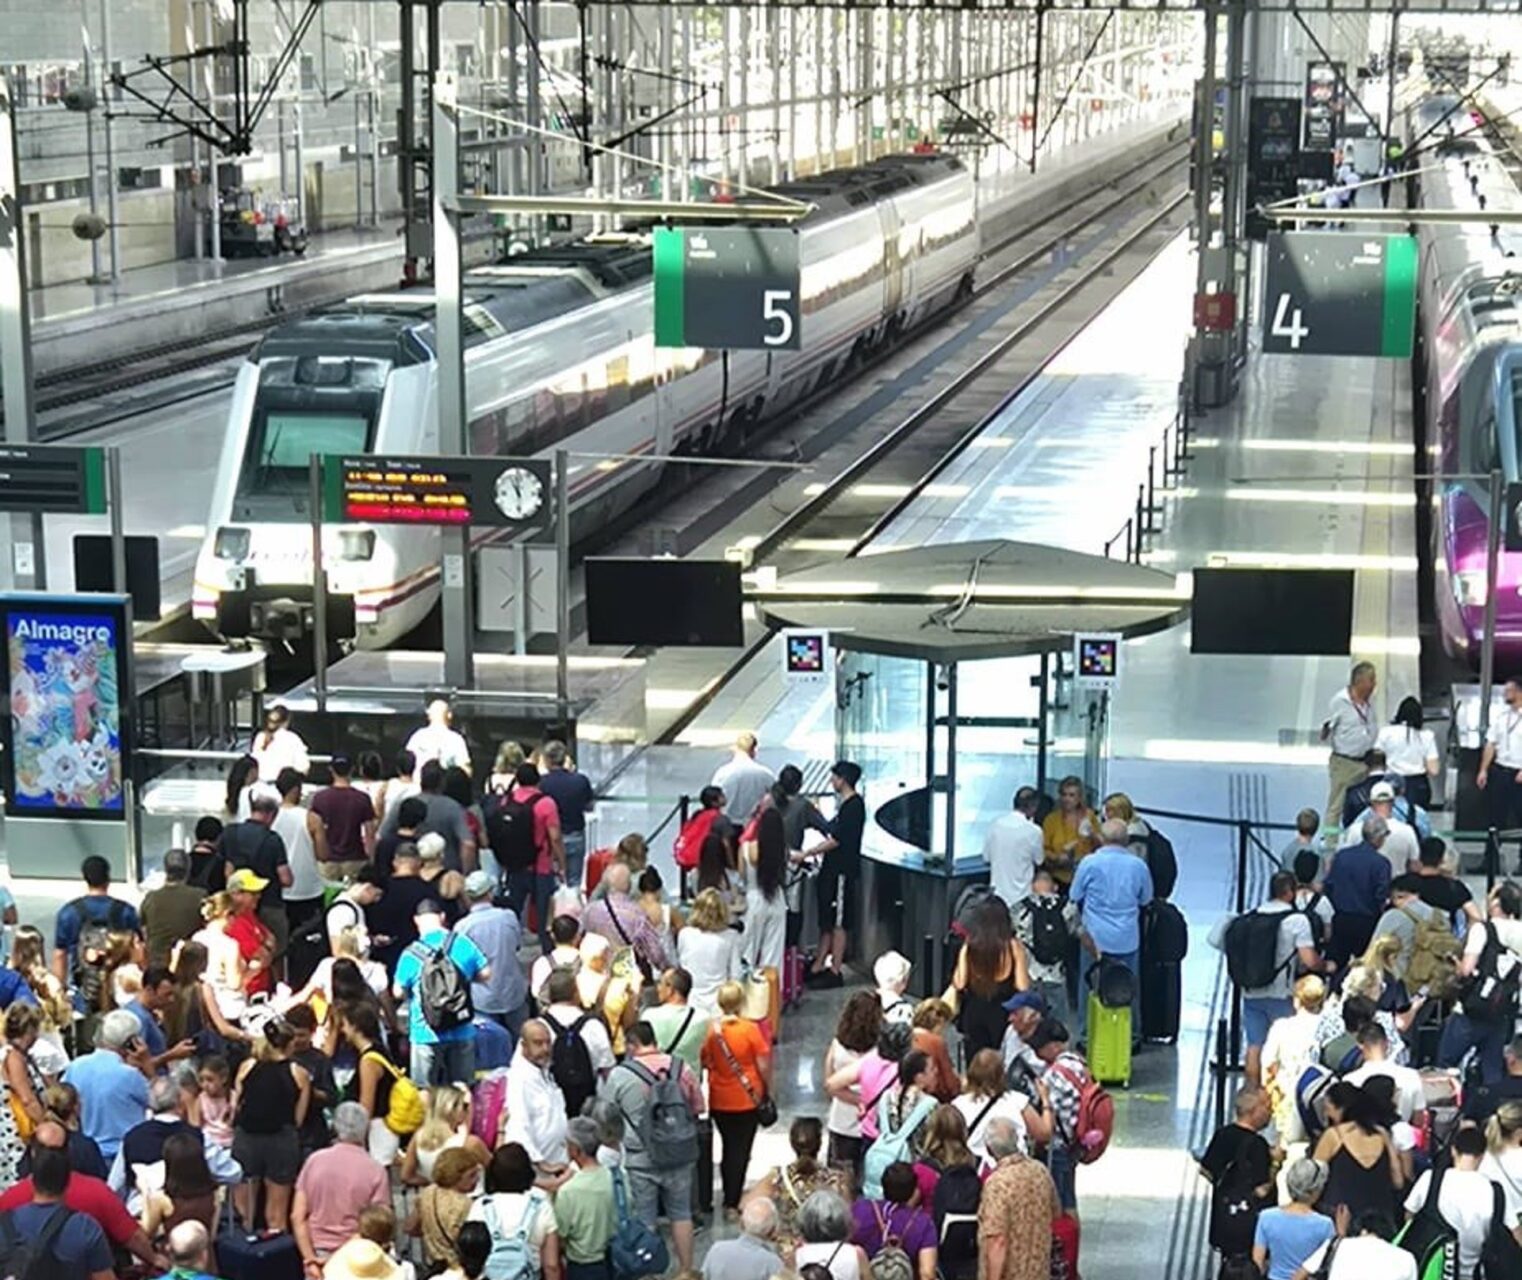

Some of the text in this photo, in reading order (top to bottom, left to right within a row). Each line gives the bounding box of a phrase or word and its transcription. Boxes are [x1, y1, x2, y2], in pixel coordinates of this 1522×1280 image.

[763, 289, 793, 345] 5
[1271, 293, 1309, 348] 4
[15, 619, 111, 645] Almagro
